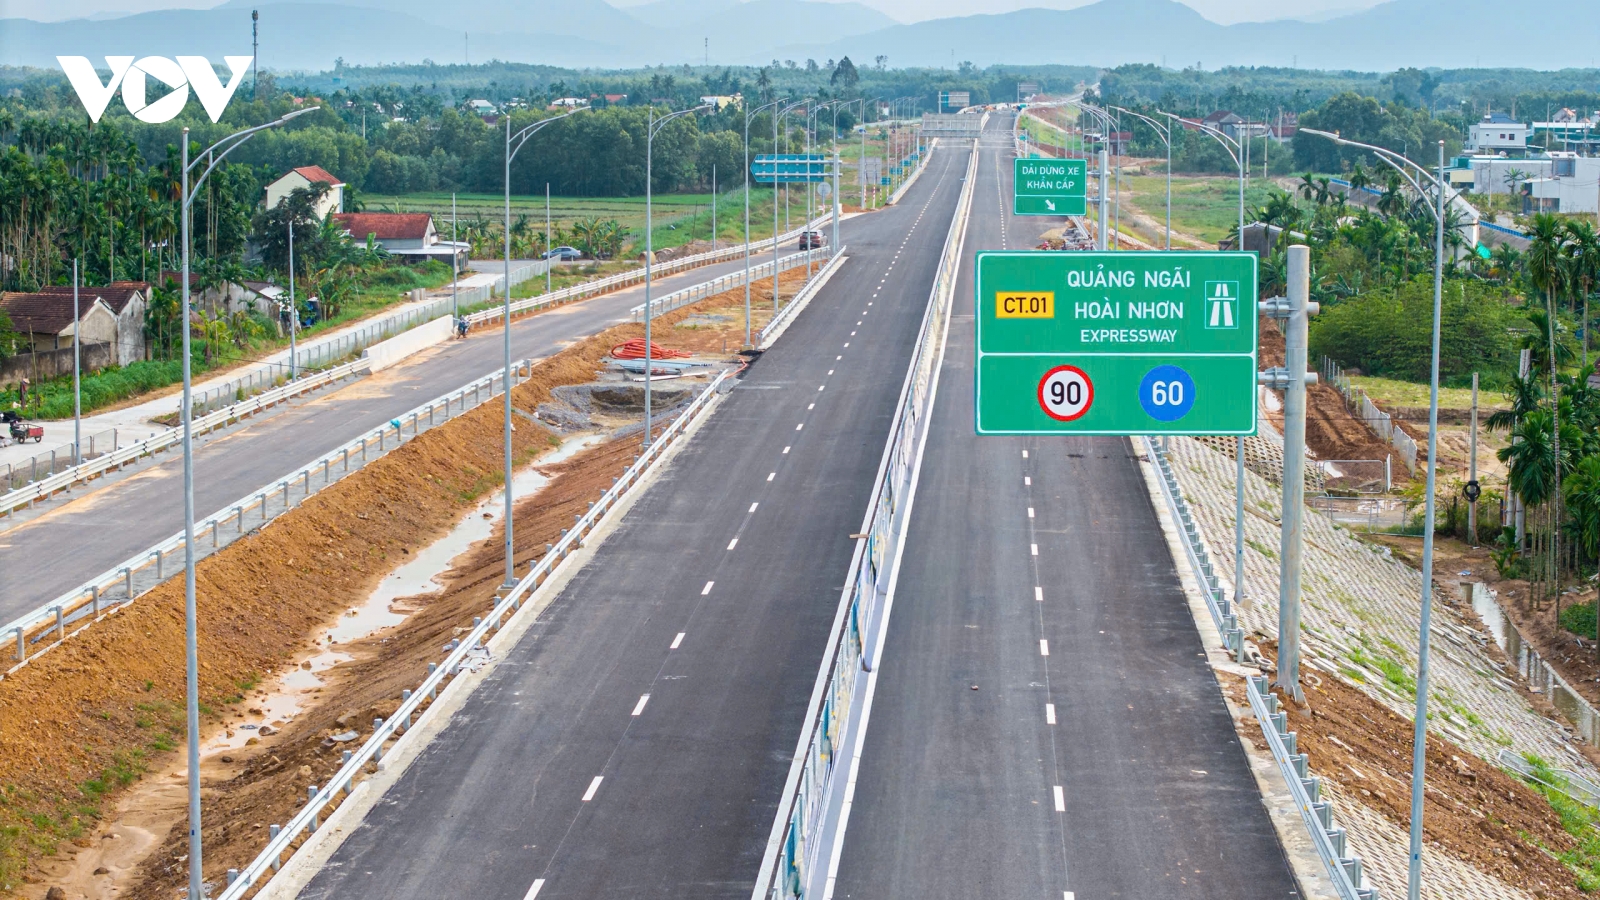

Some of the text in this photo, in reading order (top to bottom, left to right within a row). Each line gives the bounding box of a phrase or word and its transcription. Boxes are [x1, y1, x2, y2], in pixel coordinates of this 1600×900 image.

[1022, 163, 1080, 175] DẢI DỪNG XE
[1027, 176, 1075, 189] KHẨN CẤP
[1067, 264, 1191, 288] QUẢNG NGÃI
[1003, 297, 1047, 314] CT.01
[1074, 297, 1184, 319] HOÀI NHƠN
[1080, 329, 1177, 342] EXPRESSWAY
[1050, 381, 1081, 406] 90
[1152, 381, 1183, 406] 60
